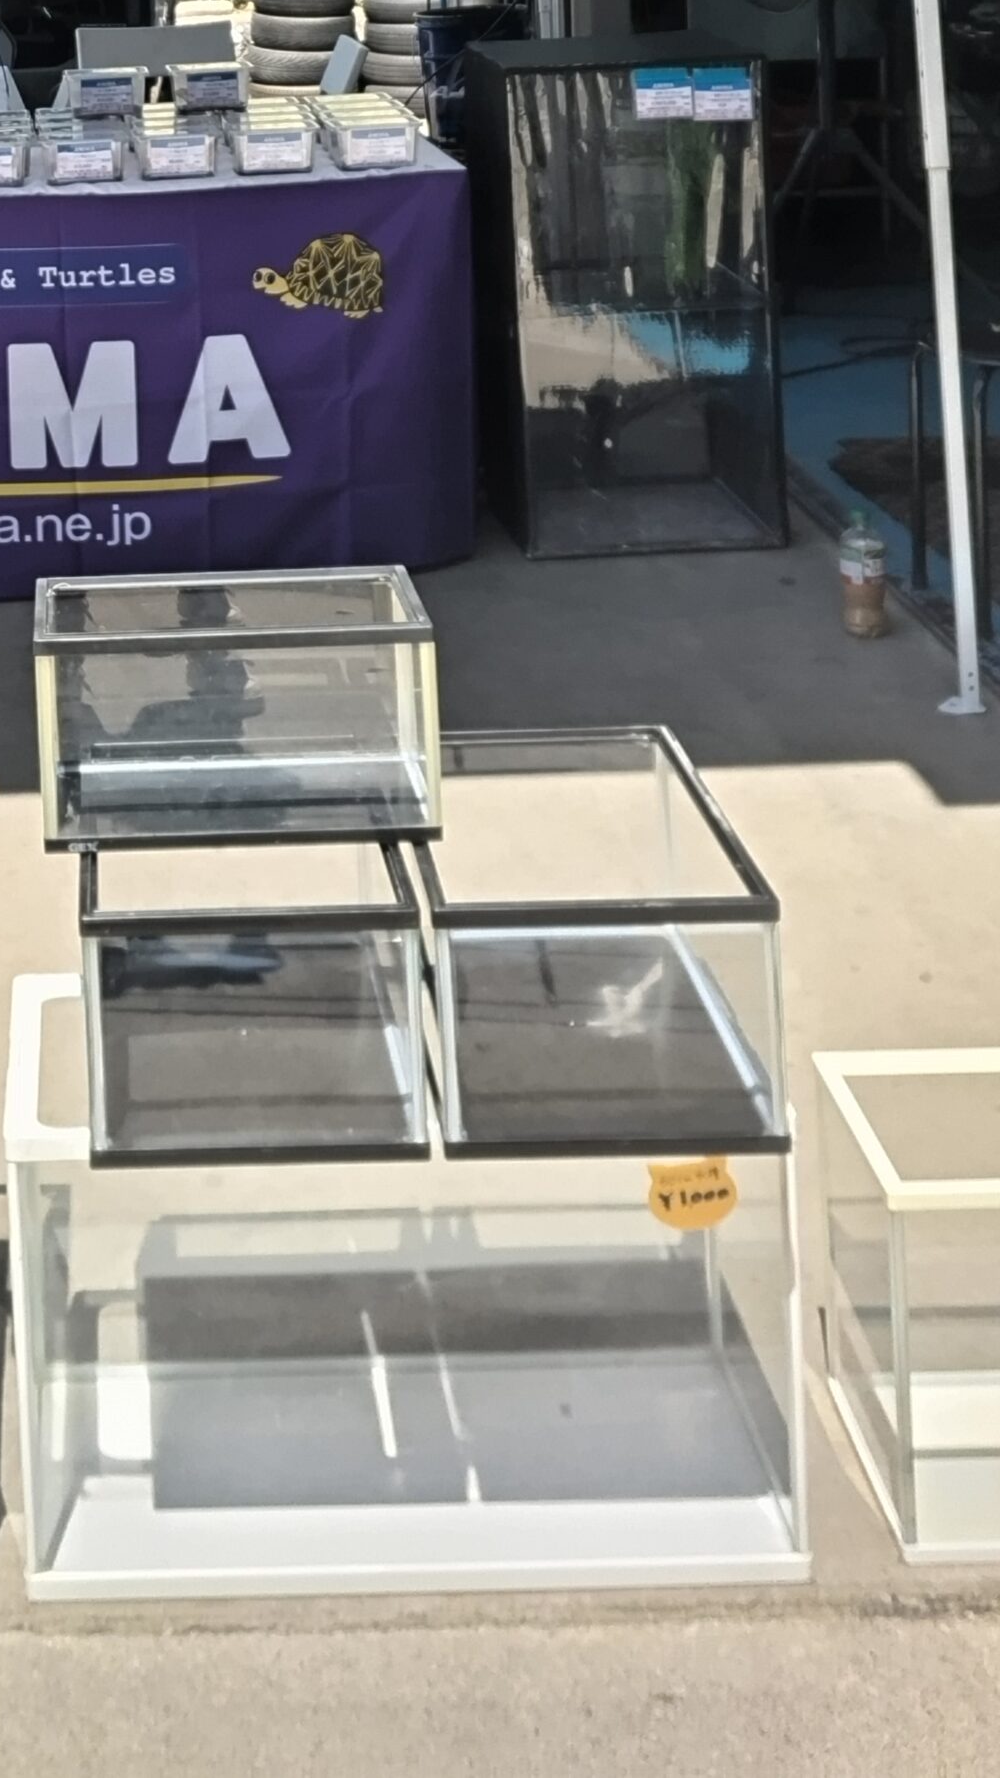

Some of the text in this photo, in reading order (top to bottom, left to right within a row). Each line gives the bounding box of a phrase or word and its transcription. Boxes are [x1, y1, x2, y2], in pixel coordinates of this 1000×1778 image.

[0, 269, 17, 289] &
[38, 263, 177, 289] Turtles
[67, 840, 99, 852] GEX
